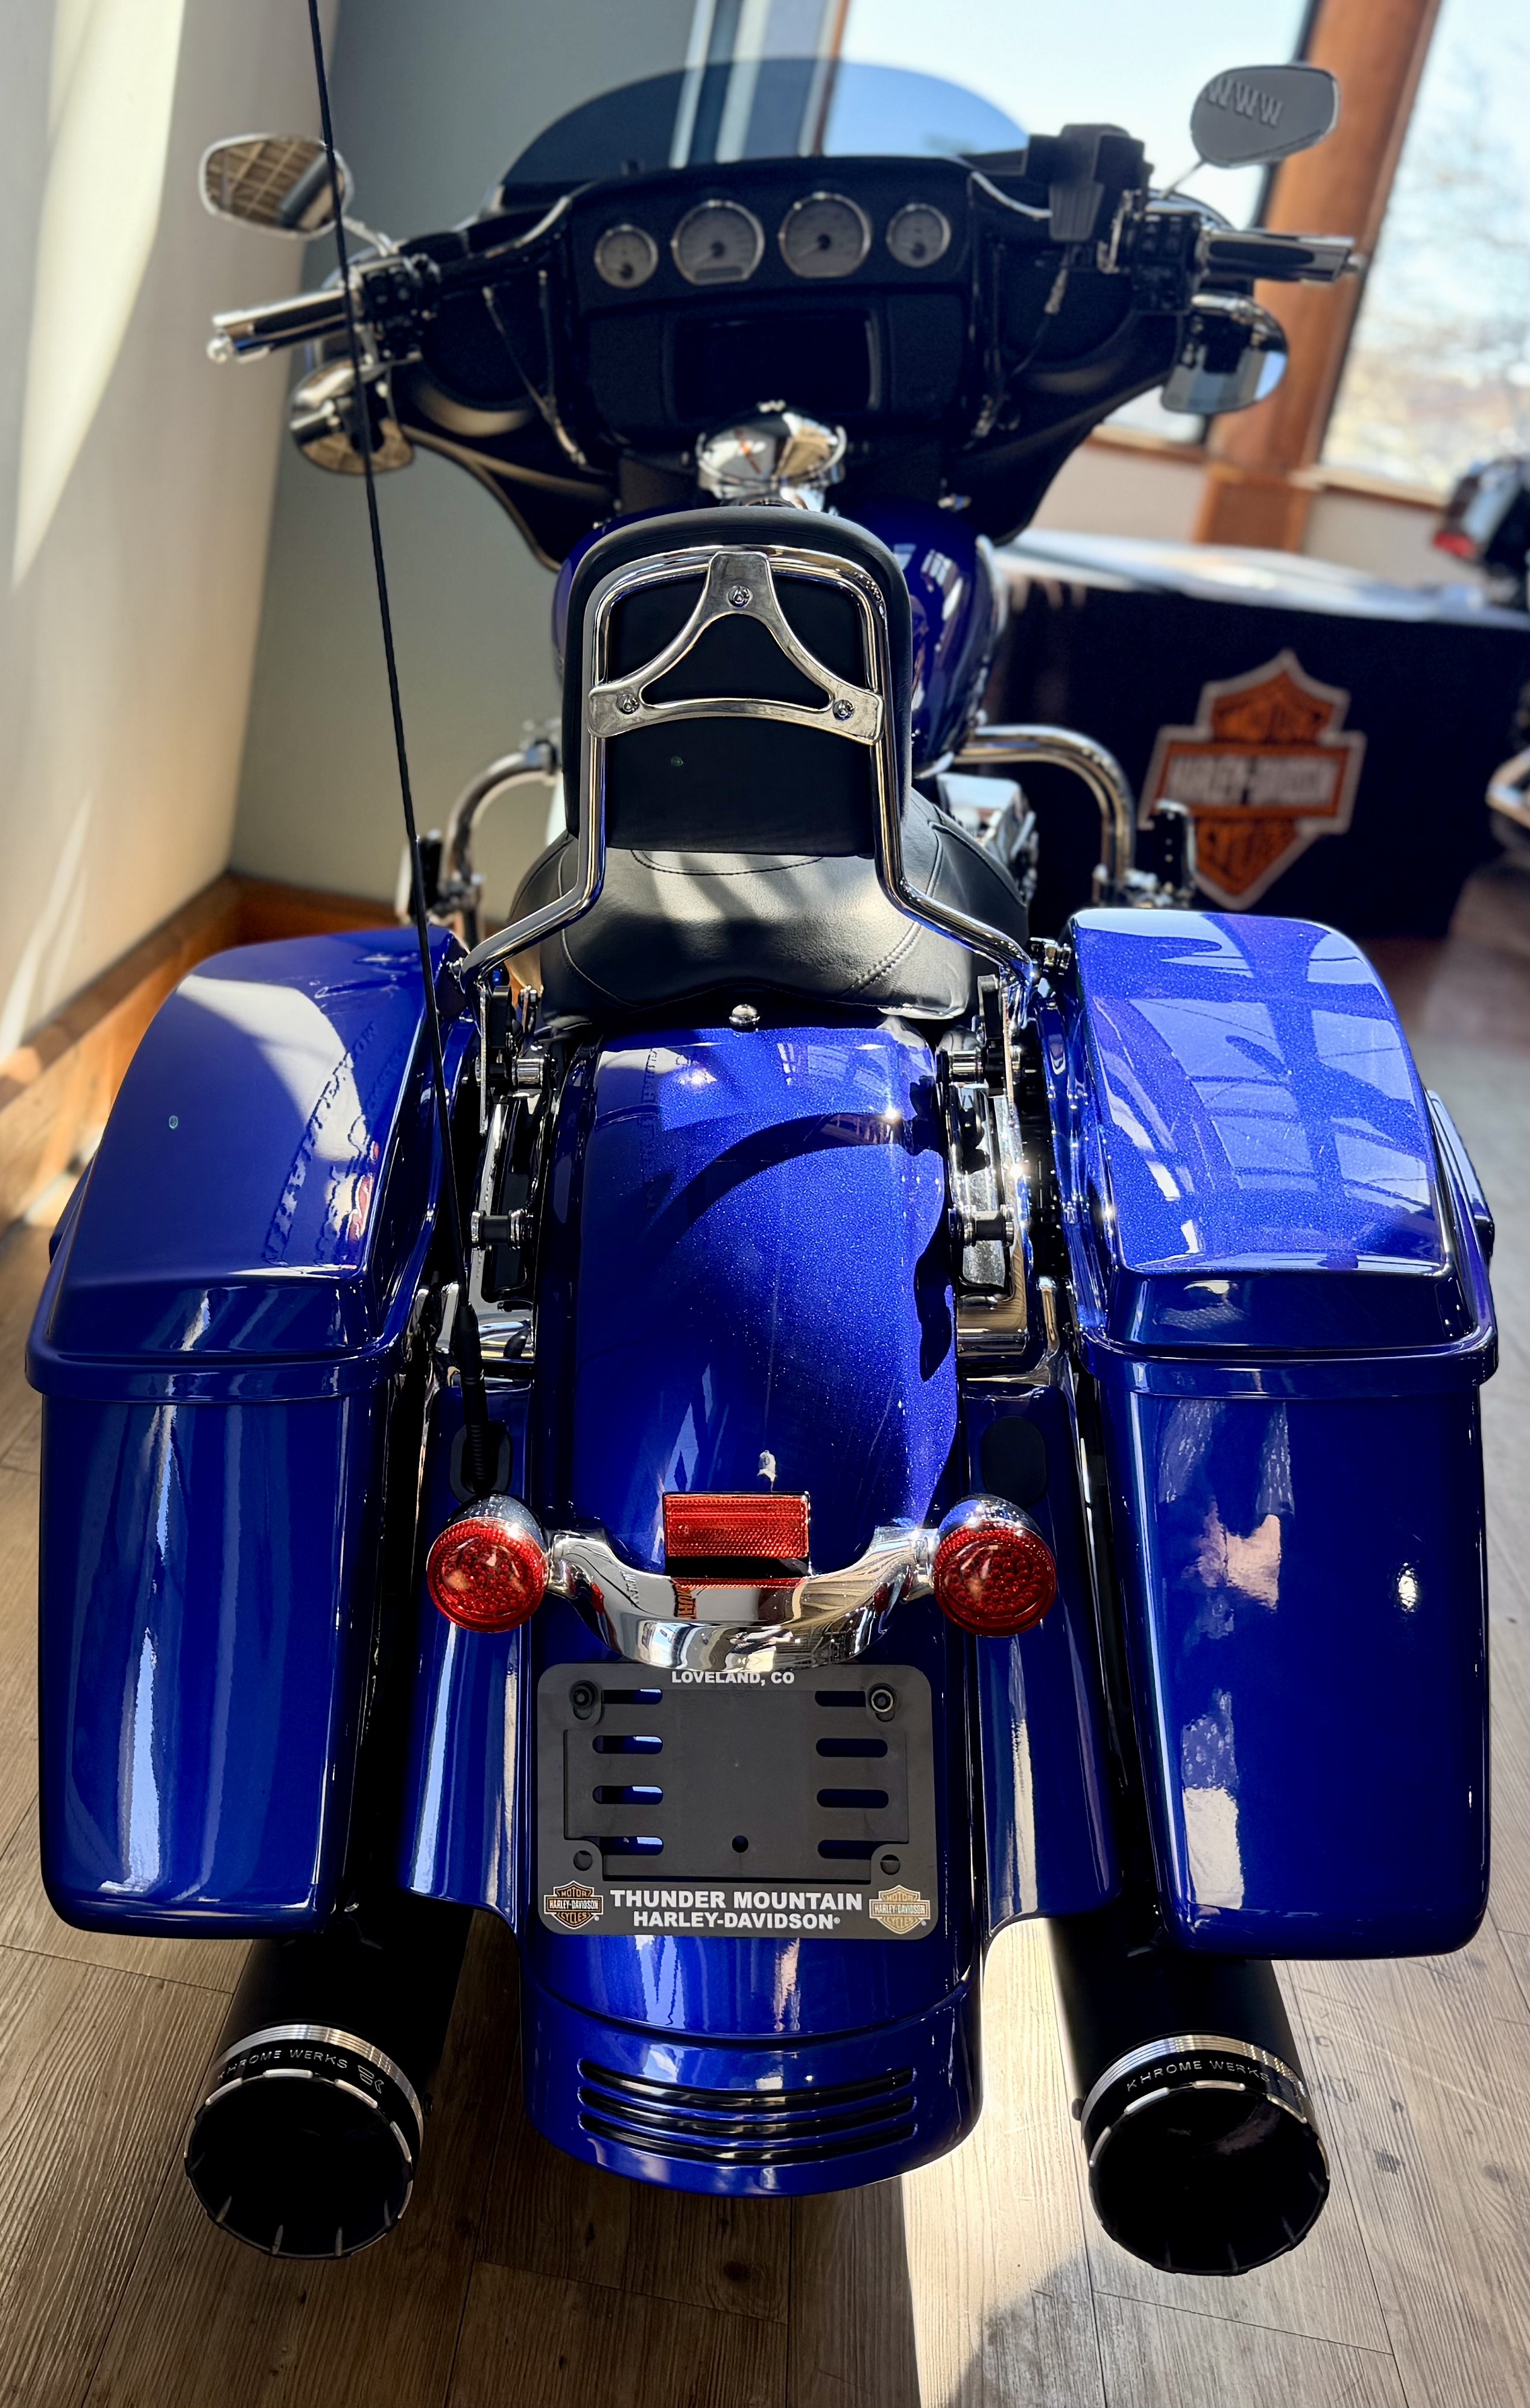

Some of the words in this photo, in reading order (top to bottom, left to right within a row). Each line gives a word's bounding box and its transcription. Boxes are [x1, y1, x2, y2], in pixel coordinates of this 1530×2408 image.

[671, 1671, 766, 1686] LOVELAND,
[770, 1671, 795, 1685] CO
[610, 1890, 727, 1909] THUNDER
[733, 1891, 863, 1911] MOUNTAIN
[289, 2049, 349, 2069] WERKS
[1126, 2060, 1203, 2092] KHROME
[1209, 2060, 1271, 2082] WERKS
